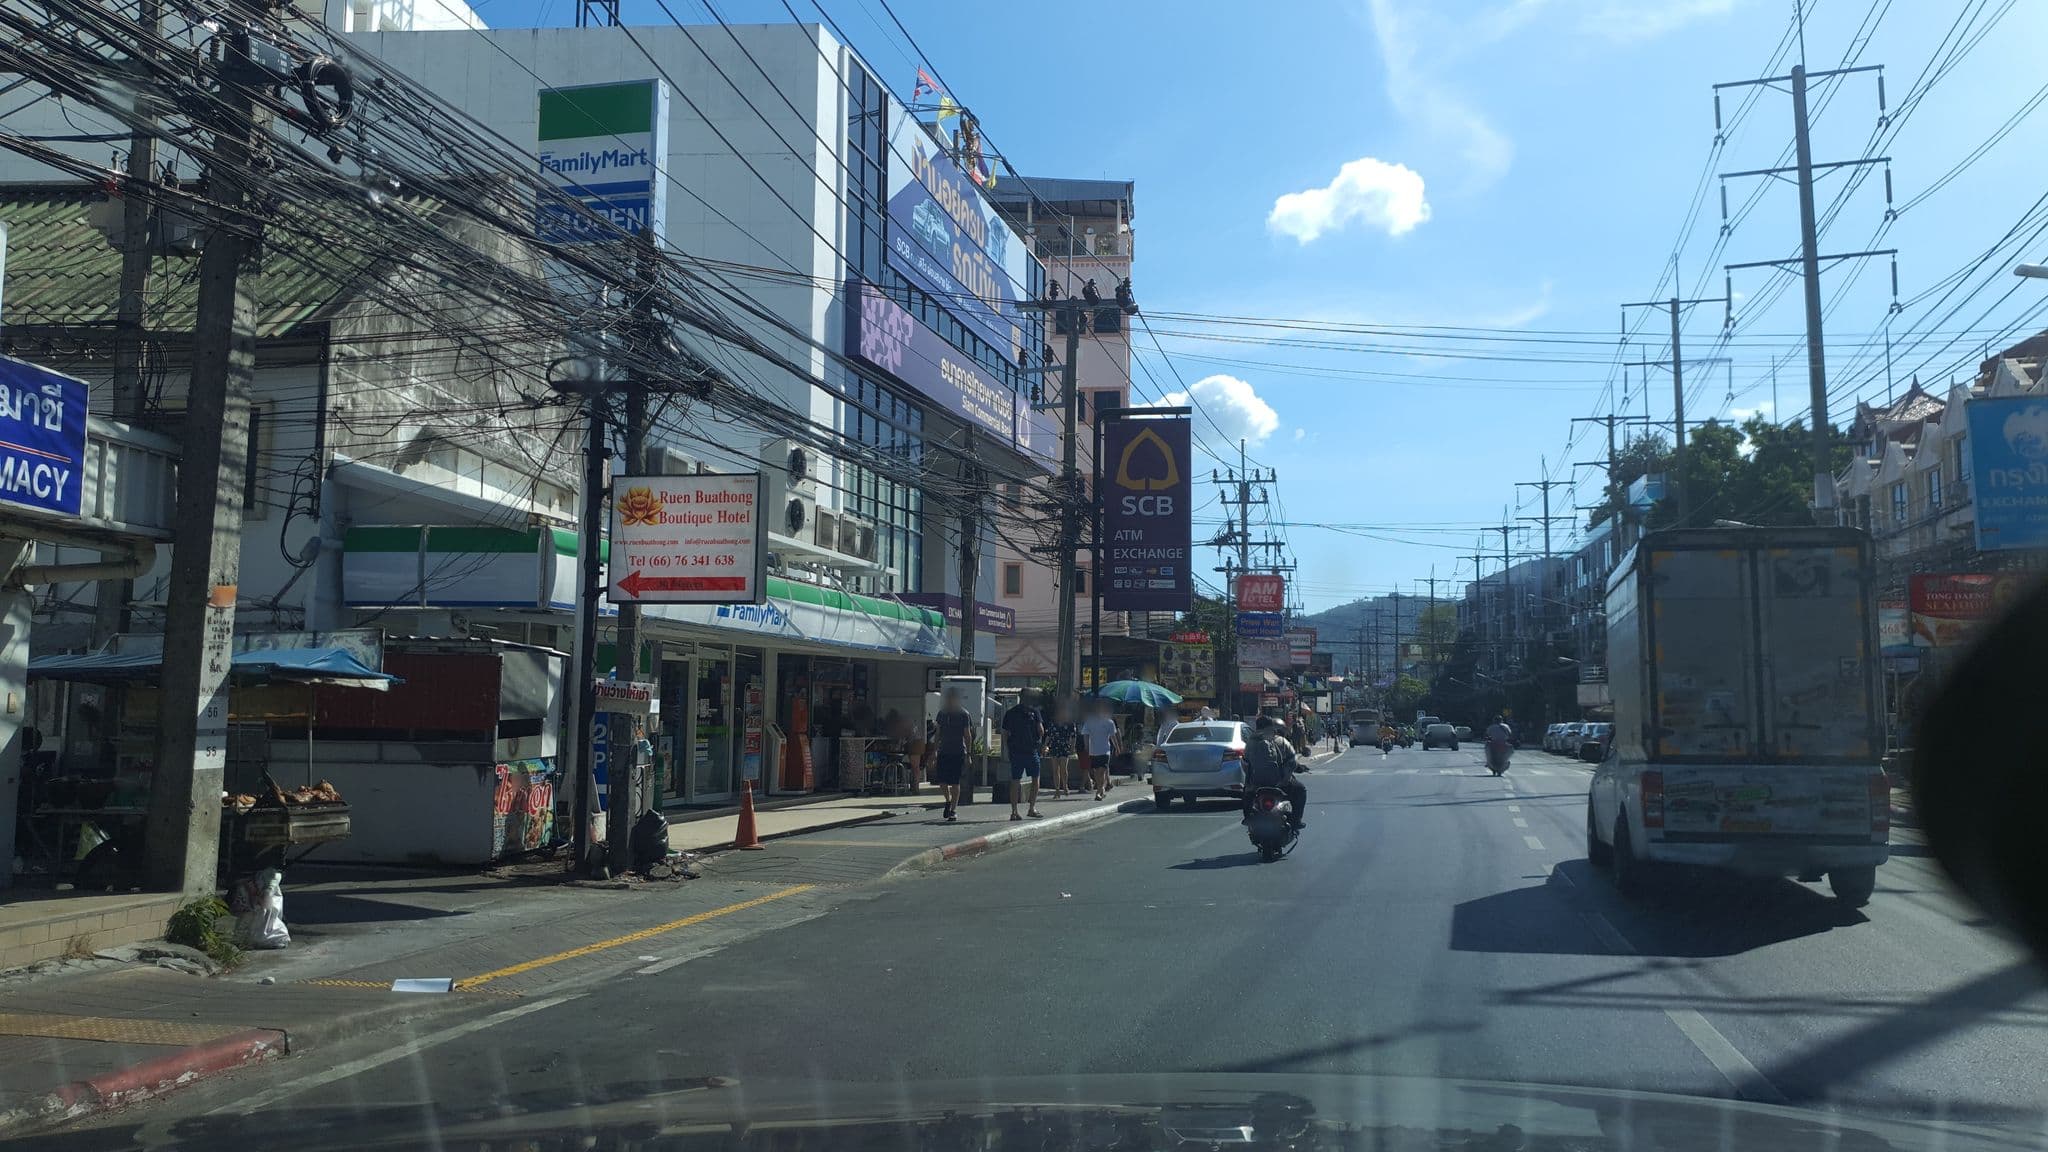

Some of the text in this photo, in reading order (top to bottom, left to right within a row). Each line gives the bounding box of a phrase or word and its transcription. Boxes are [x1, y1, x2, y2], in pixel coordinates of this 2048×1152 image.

[539, 148, 648, 175] FamilyMart
[896, 237, 911, 260] SCB
[660, 490, 753, 506] Ruen Buathong
[1121, 496, 1174, 516] SCB
[659, 510, 750, 527] Boutique Hotel
[1114, 529, 1143, 541] ATM
[629, 555, 735, 568] Tel (66) 76 341 638
[1113, 548, 1184, 559] EXCHANGE
[732, 604, 788, 627] FamilyMart
[207, 707, 218, 718] 56
[206, 746, 217, 757] 55
